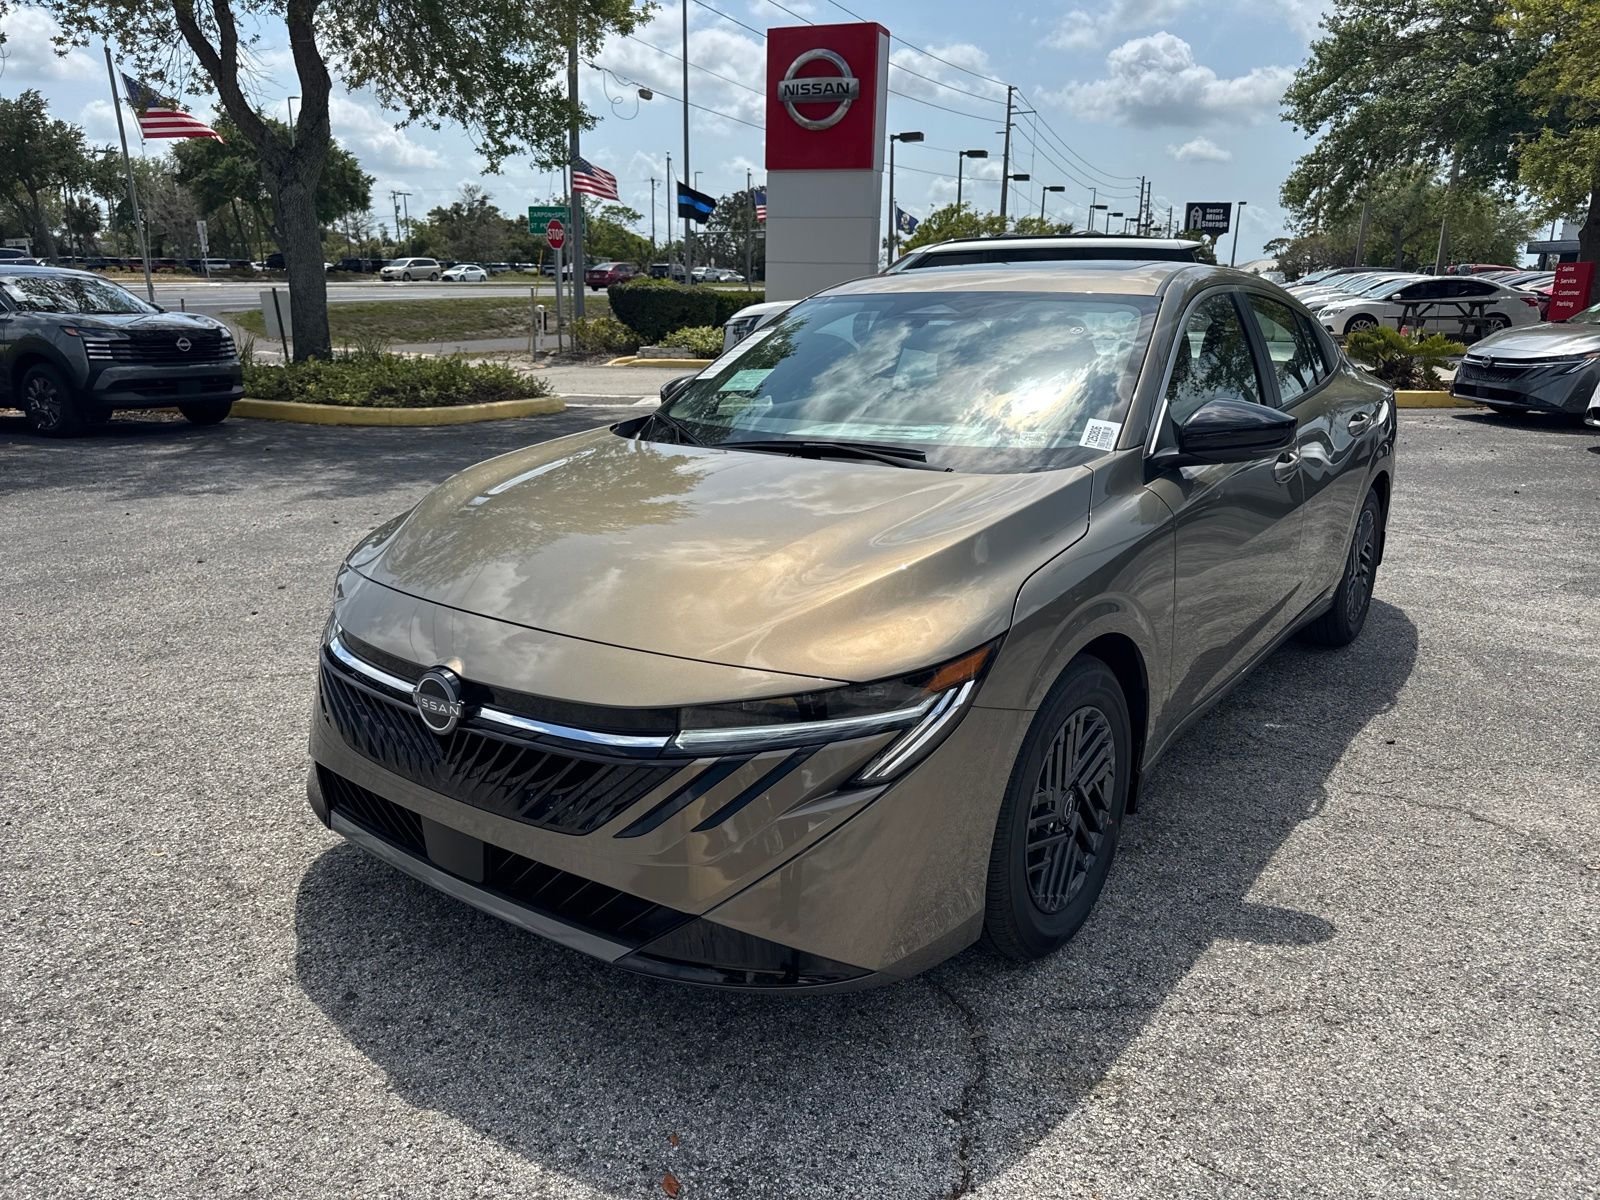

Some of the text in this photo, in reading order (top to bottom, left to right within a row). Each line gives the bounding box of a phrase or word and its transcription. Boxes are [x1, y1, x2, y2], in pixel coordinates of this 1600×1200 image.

[784, 82, 850, 97] NISSAN
[1201, 220, 1228, 229] Storage
[548, 229, 564, 240] STOP
